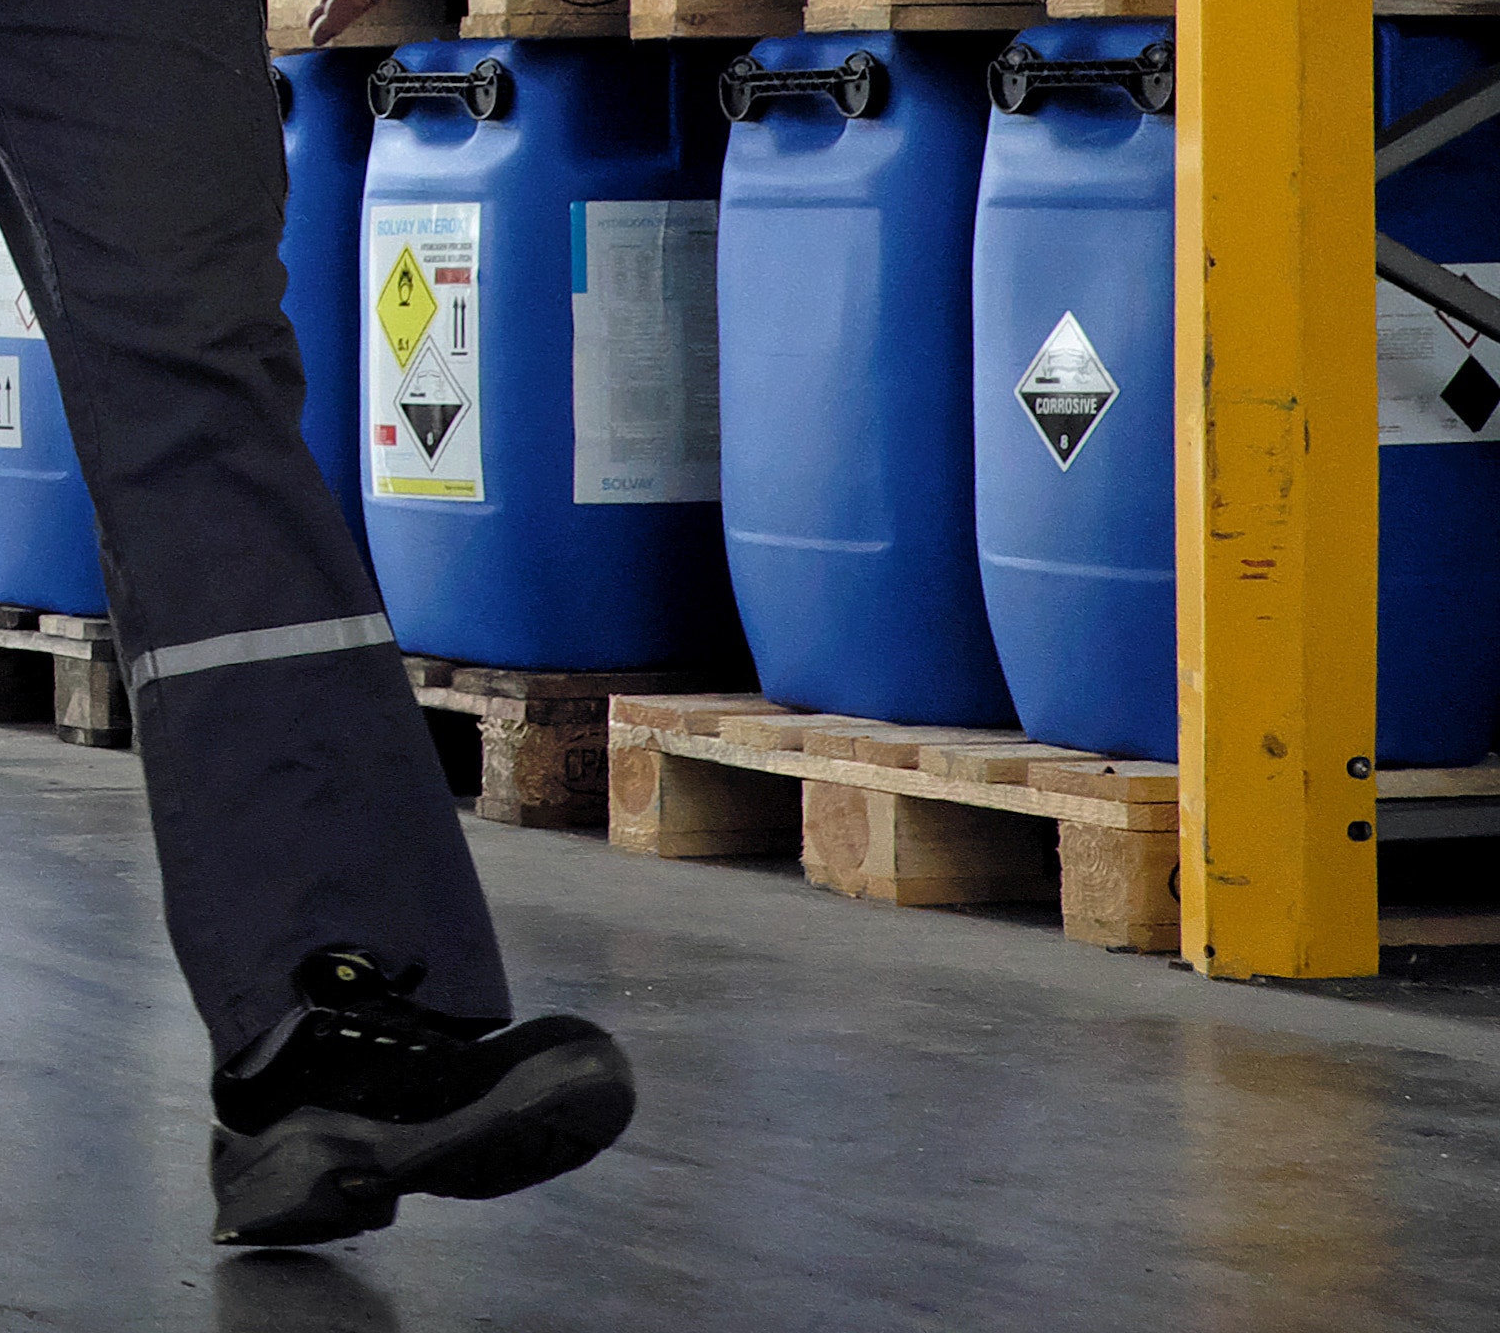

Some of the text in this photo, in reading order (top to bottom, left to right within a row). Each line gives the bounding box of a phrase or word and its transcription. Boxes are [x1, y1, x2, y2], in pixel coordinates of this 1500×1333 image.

[377, 219, 415, 236] SOLVAY
[1035, 397, 1098, 415] CORROSIVE
[1060, 434, 1069, 450] 8
